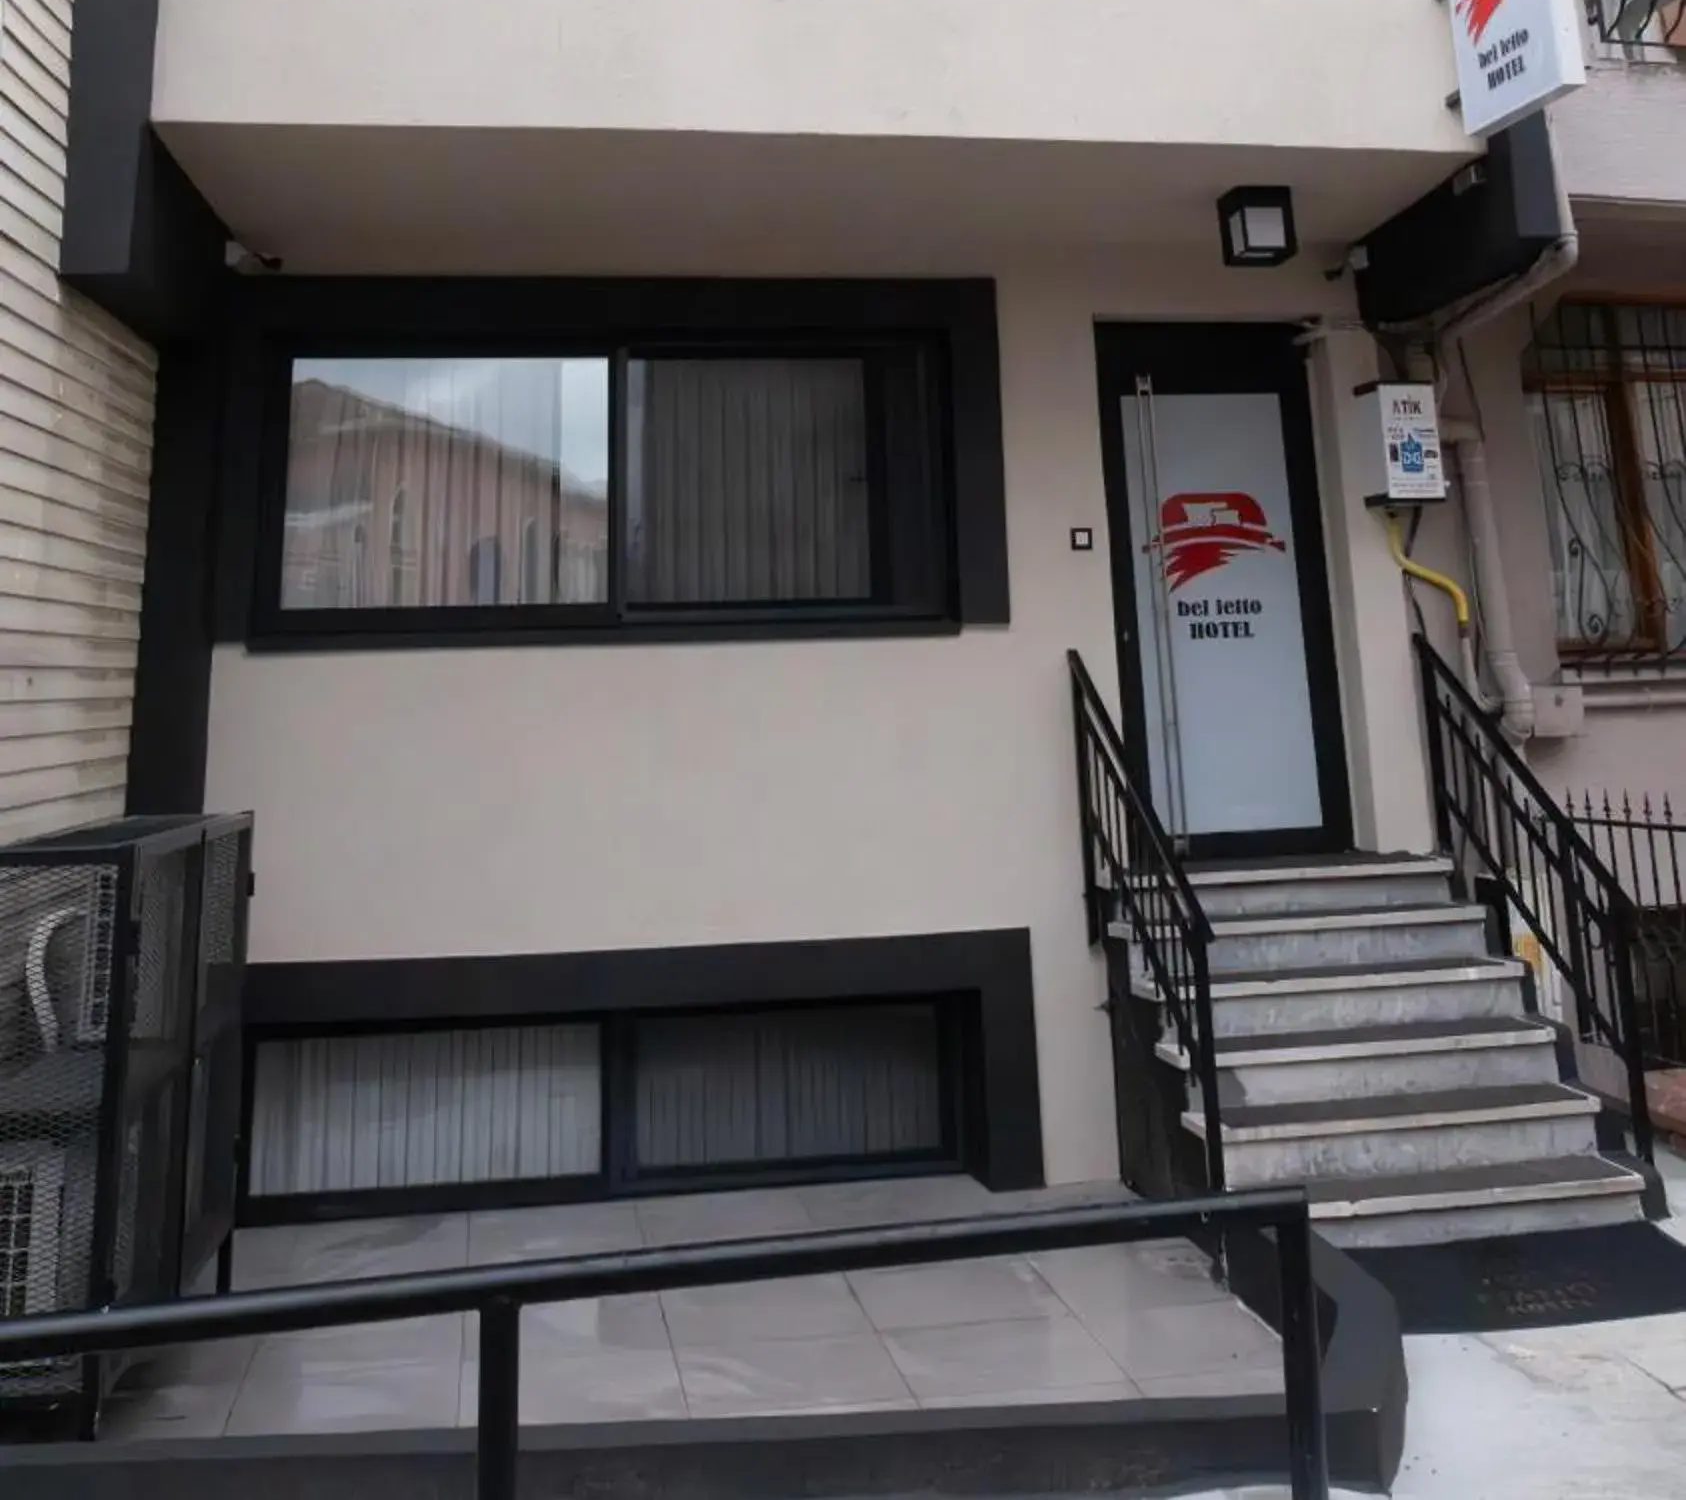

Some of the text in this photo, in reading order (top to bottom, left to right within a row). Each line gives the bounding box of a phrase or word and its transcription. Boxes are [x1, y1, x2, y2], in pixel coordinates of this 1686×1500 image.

[1477, 28, 1529, 69] bel letto
[1487, 54, 1526, 90] HOTEL
[1177, 599, 1263, 617] bel letto
[1189, 620, 1255, 640] HOTEL
